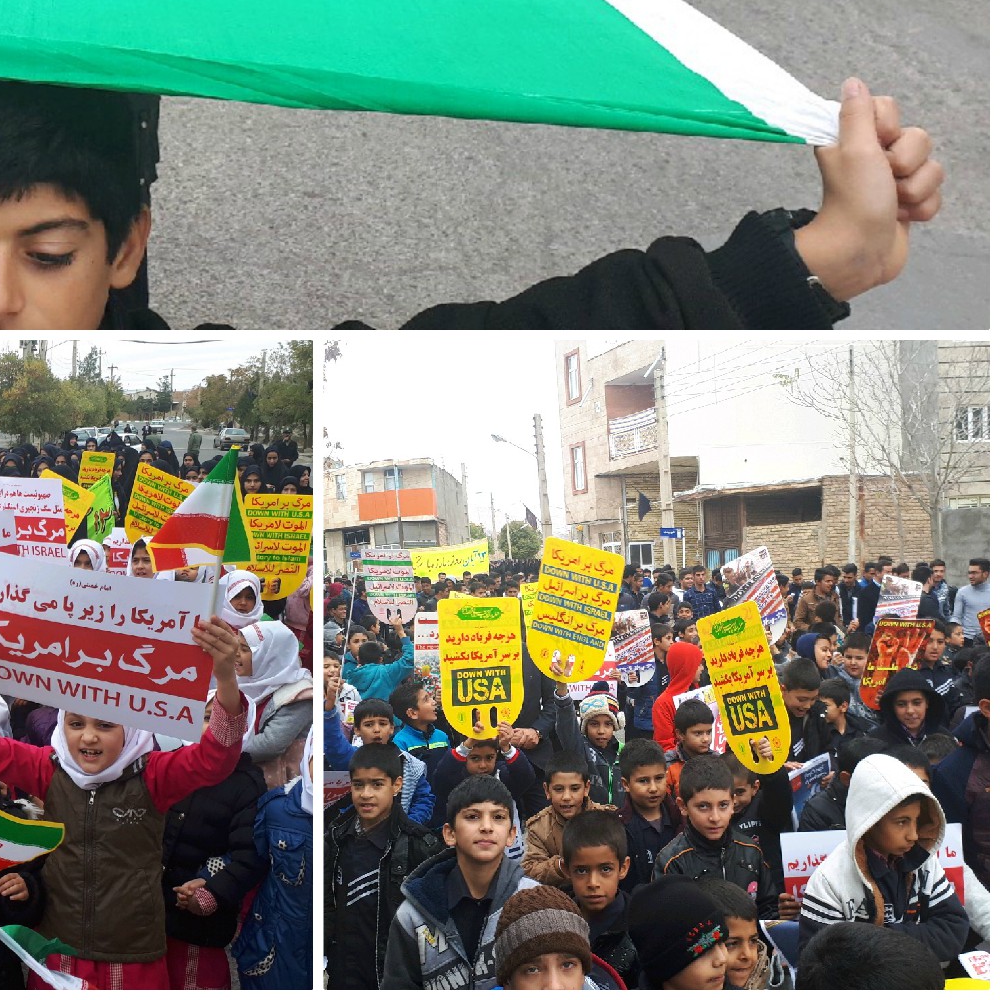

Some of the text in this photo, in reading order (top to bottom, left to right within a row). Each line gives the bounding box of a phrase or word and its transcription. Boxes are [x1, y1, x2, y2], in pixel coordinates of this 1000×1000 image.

[174, 481, 188, 493] مرگ
[252, 497, 310, 509] مرگ بر امریکا
[2, 528, 11, 538] ما
[16, 519, 64, 541] مرگ بر
[32, 546, 66, 558] ISRAEL
[552, 549, 614, 576] مرگ بر امریکا
[544, 566, 614, 591] DOWN WITH U.S.A
[543, 579, 611, 606] مرگ بر اسرائیل
[34, 599, 58, 612] می
[62, 595, 74, 619] پا
[78, 604, 104, 623] زیر
[110, 604, 126, 626] را
[539, 593, 609, 619] DOWN WITH ISRAEL
[130, 606, 190, 633] آمریکا
[537, 612, 605, 636] مرگ بر انگلیس
[446, 633, 469, 645] دارید
[470, 631, 491, 644] فریاد
[533, 621, 605, 647] DOWN WITH ENGLAND
[62, 648, 113, 673] بر
[118, 645, 198, 685] مرگ
[443, 649, 519, 664] بر سر آمریکا بکشید
[457, 669, 506, 679] DOWN WITH
[732, 666, 753, 684] آمریکا
[756, 669, 765, 681] سر
[457, 677, 507, 702] USA
[727, 689, 766, 705] DOWN WITH
[57, 679, 121, 707] WITH
[129, 694, 194, 724] U.S.A
[729, 700, 774, 732] USA
[946, 846, 957, 859] ما
